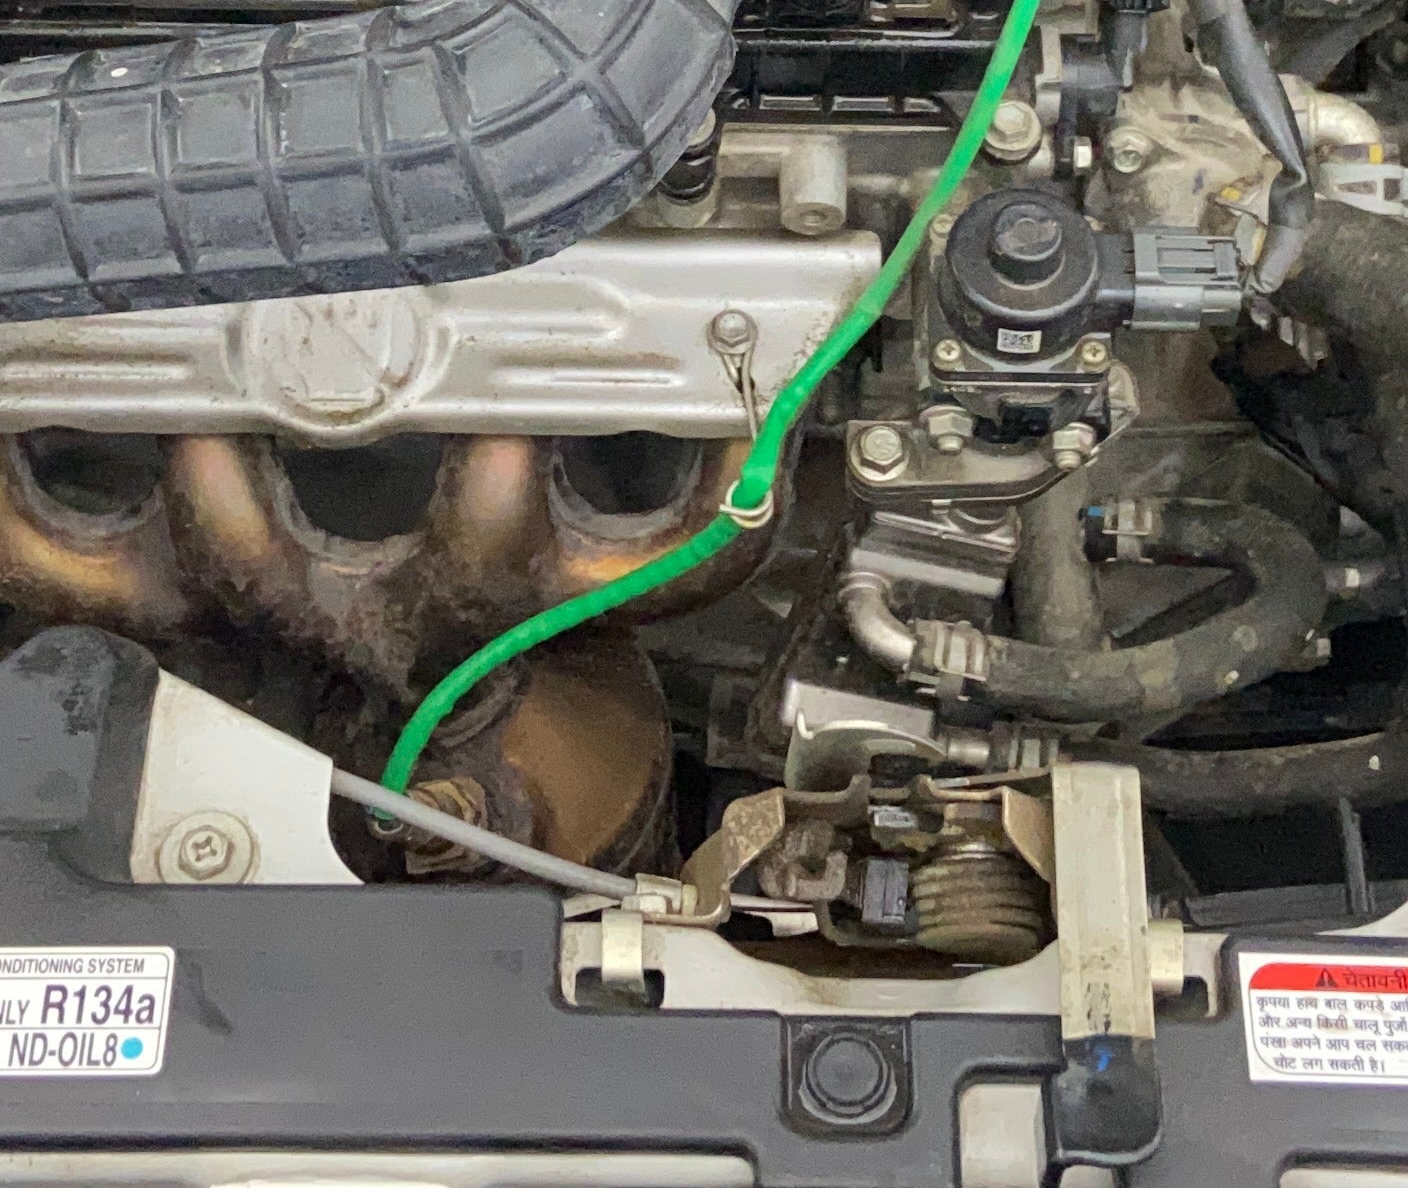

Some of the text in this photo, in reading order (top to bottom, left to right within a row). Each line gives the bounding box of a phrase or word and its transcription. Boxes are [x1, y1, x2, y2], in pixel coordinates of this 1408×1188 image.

[87, 958, 145, 973] SYSTEM
[1343, 968, 1408, 990] चेतावनी
[40, 984, 156, 1025] R134a
[1256, 996, 1290, 1012] कृपया
[1296, 997, 1318, 1009] हाथ
[1324, 998, 1347, 1010] बाल
[1259, 1016, 1280, 1028] और
[1286, 1018, 1312, 1029] अन्य
[1317, 1016, 1349, 1030] किसी
[1353, 1019, 1381, 1035] चालू
[8, 1032, 118, 1067] ND-OIL8
[1260, 1033, 1286, 1049] पंखा
[1291, 1035, 1321, 1050] अपने
[1326, 1038, 1350, 1051] आप
[1356, 1039, 1377, 1051] चल
[1273, 1054, 1297, 1068] चोट
[1301, 1057, 1323, 1072] लग
[1329, 1056, 1364, 1072] सकती
